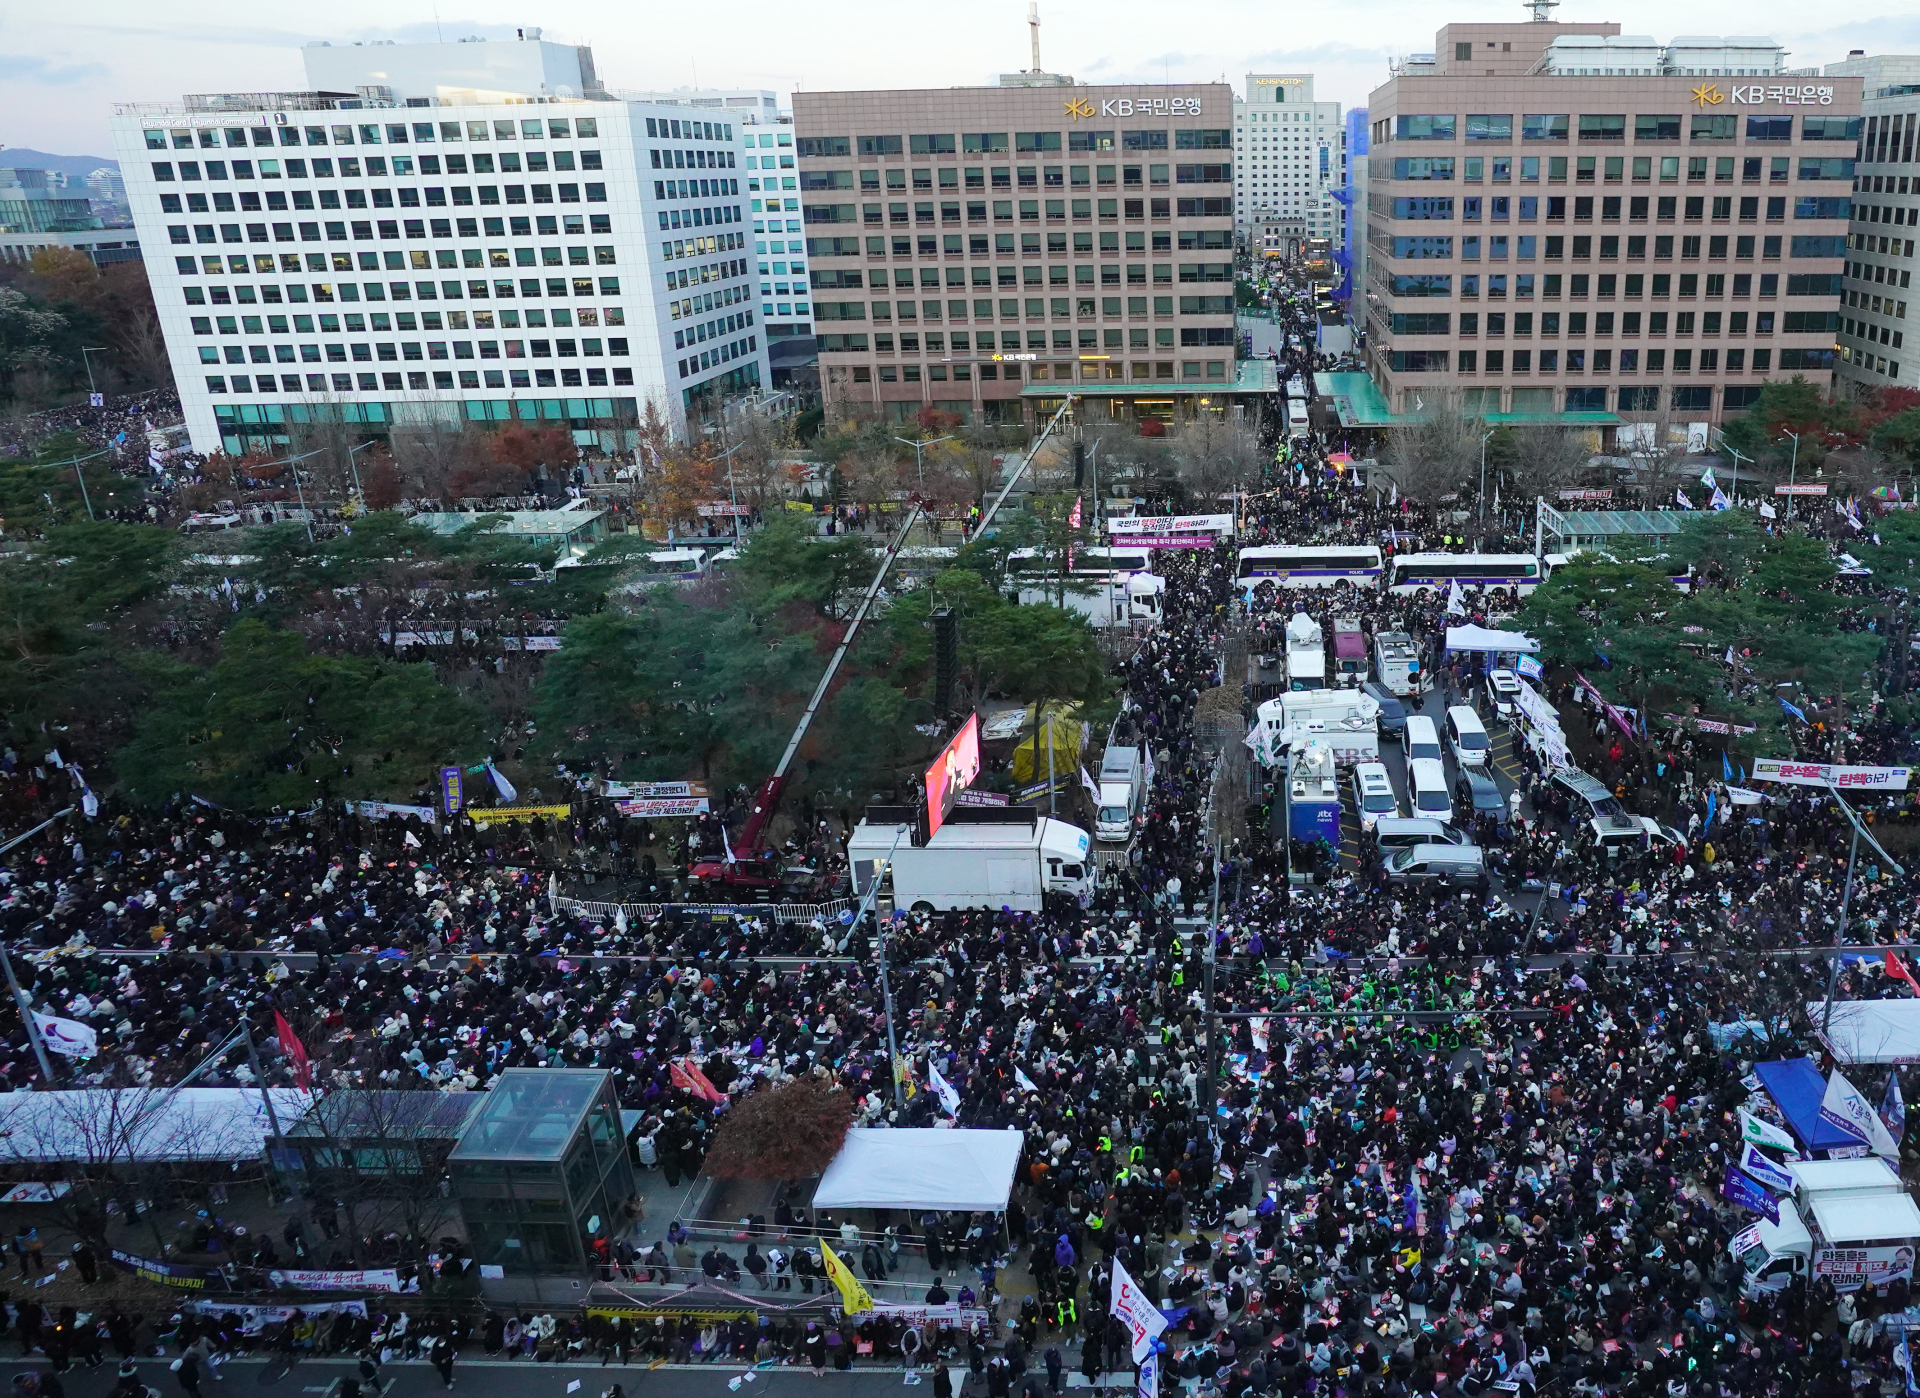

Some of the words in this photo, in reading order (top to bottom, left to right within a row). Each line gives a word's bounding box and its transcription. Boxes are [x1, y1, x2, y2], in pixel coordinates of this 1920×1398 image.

[1116, 520, 1140, 528] 국민의
[1174, 519, 1209, 529] 탄핵하라!
[1839, 773, 1889, 786] 탄핵하라
[1822, 1250, 1868, 1261] 한동훈은
[1820, 1261, 1858, 1273] 윤석열
[1859, 1261, 1885, 1272] 체포
